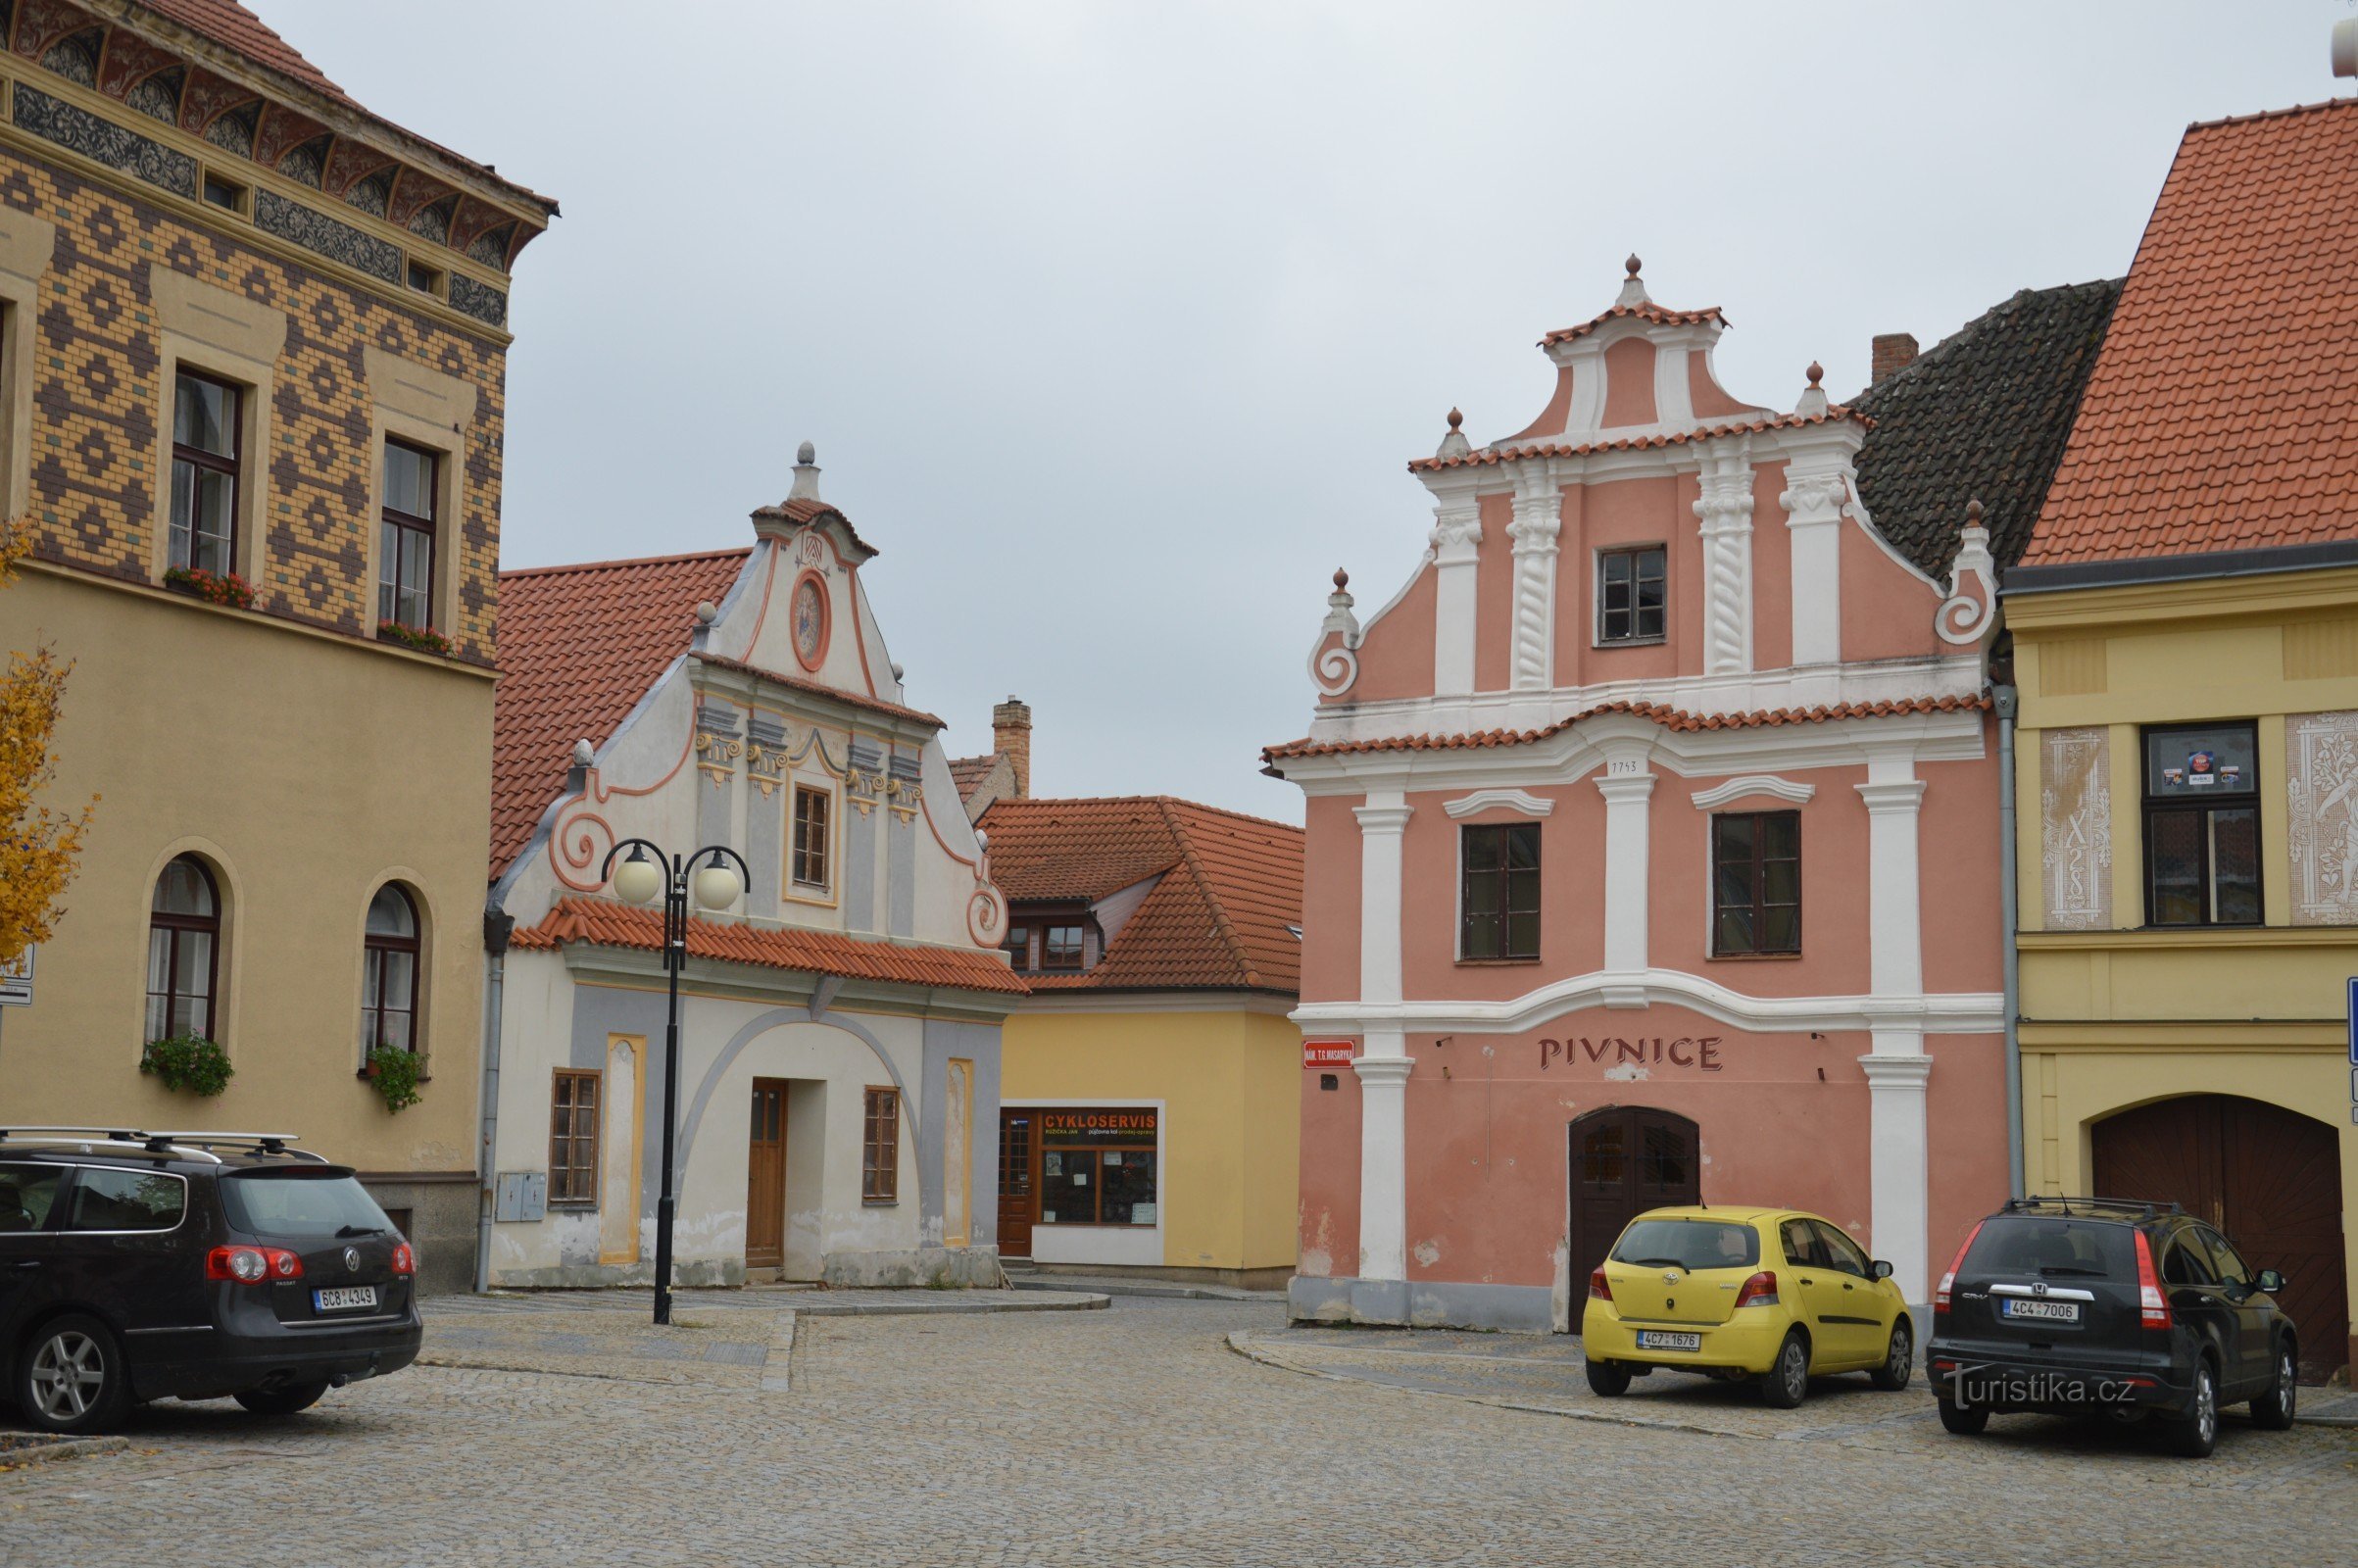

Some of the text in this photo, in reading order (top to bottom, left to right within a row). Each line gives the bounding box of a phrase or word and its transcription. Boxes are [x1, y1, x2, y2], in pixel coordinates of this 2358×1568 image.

[1611, 760, 1637, 774] 1743
[1537, 1036, 1724, 1072] PIVNICE
[1045, 1114, 1155, 1128] CYKLOSERVIS
[322, 1288, 372, 1307] 6C8 4349
[2012, 1301, 2034, 1315] 4C4
[2043, 1304, 2073, 1318] 7006
[1645, 1333, 1695, 1347] 4C7 1676
